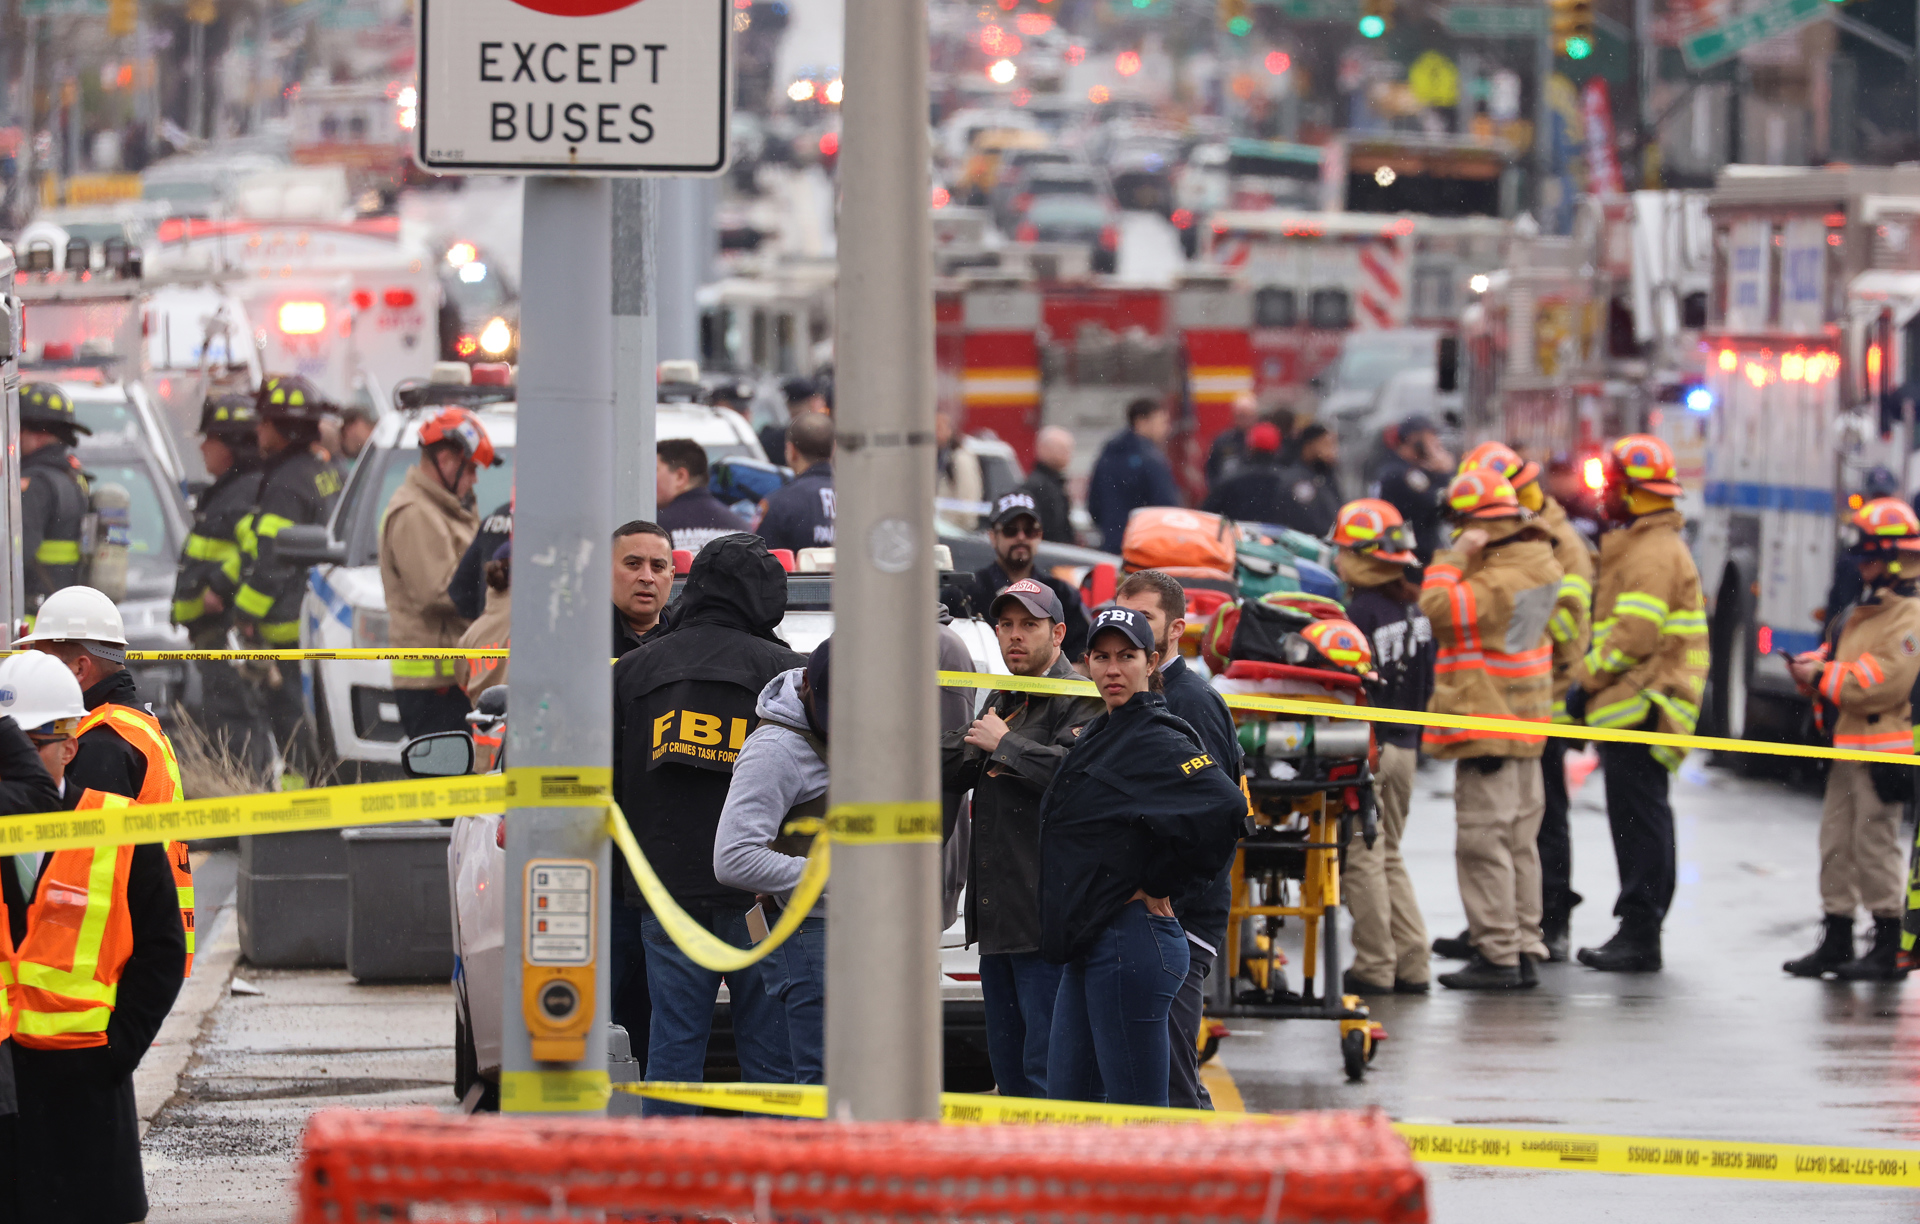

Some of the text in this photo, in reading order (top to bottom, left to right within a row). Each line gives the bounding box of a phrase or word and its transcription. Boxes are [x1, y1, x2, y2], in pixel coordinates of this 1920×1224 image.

[479, 41, 668, 84] EXCEPT
[490, 102, 655, 144] BUSES
[1097, 609, 1135, 627] FBI
[652, 709, 748, 750] FBI
[652, 741, 739, 763] VIOLENT CRIMES TASK FORC
[1181, 754, 1213, 775] FBI
[1627, 1145, 1661, 1162] CROSS
[1663, 1147, 1683, 1164] NOT
[1686, 1149, 1700, 1166] DO
[1711, 1150, 1743, 1169] SCENE
[1746, 1152, 1778, 1171] CRIME
[1795, 1154, 1908, 1177] 1-800-577-TIPS (8477)
